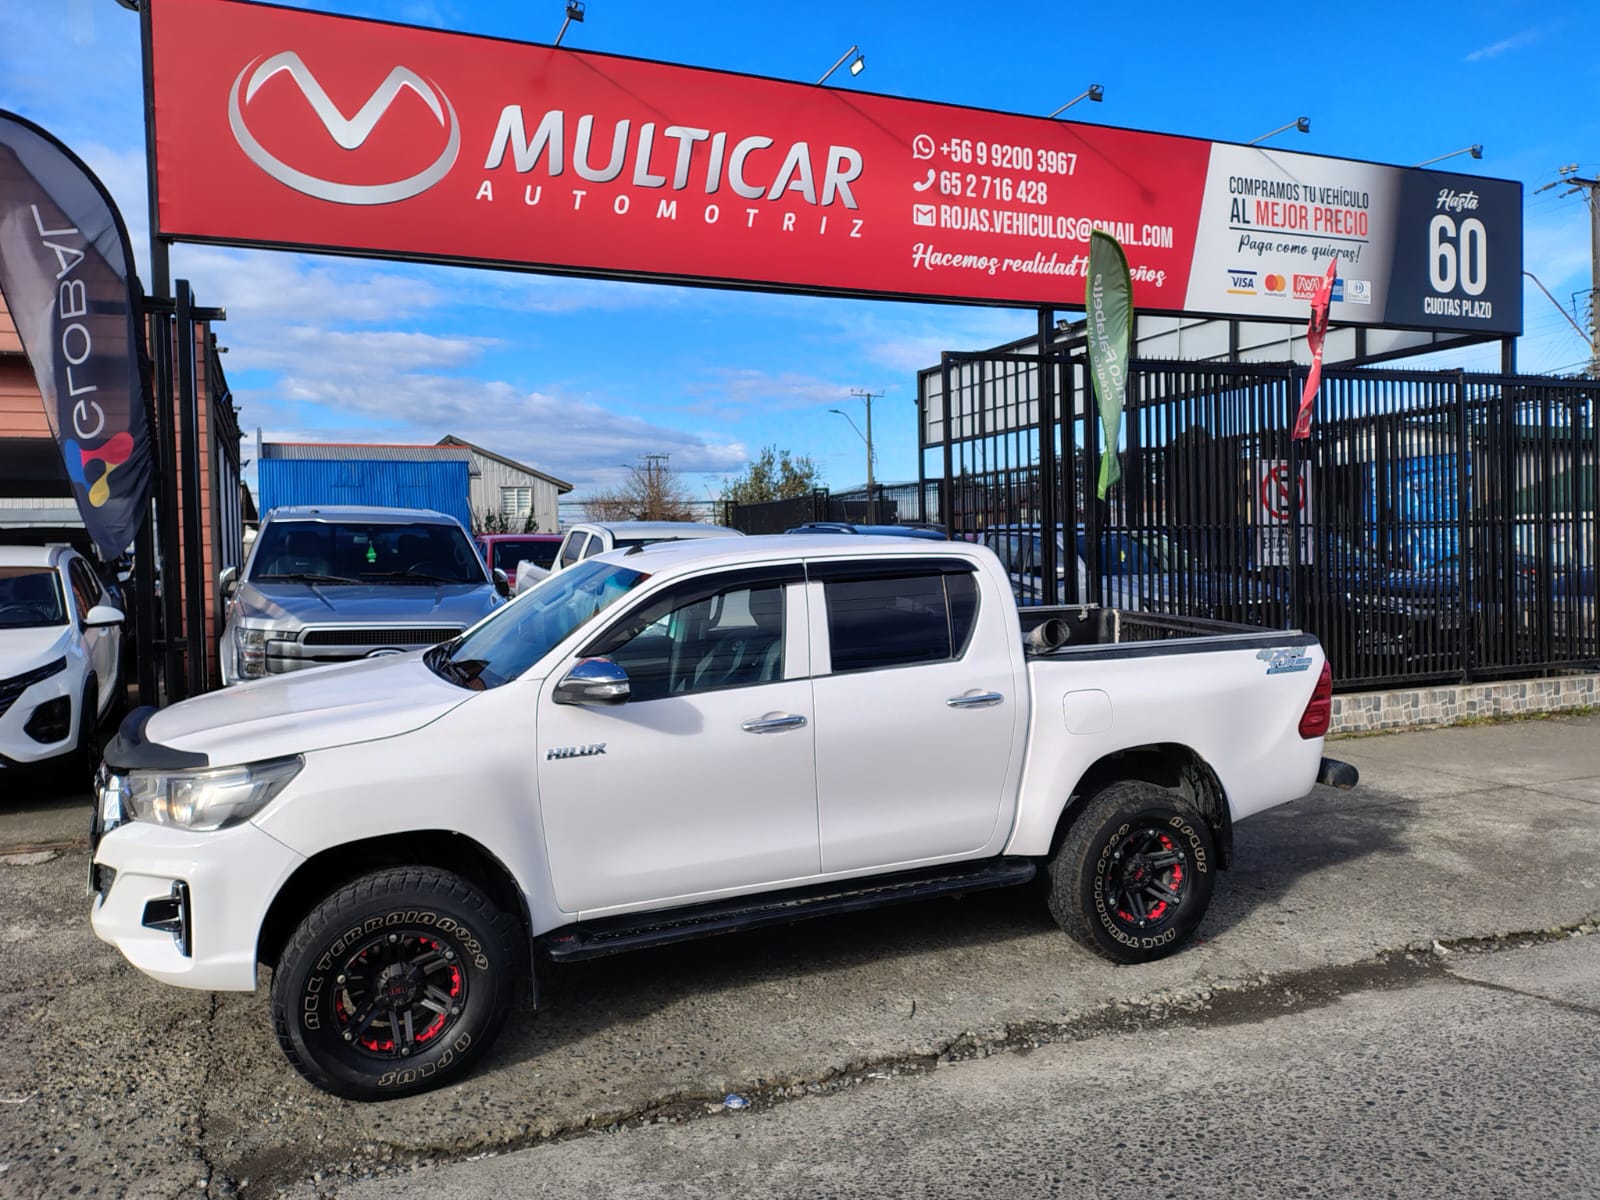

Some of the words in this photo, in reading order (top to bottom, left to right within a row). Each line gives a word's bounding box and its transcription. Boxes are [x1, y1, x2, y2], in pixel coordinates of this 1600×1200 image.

[484, 104, 864, 209] MULTICAR
[940, 138, 972, 163] +56
[976, 141, 987, 165] 9
[991, 144, 1033, 171] 9200
[1037, 149, 1077, 176] 3967
[940, 171, 961, 196] 65
[966, 174, 977, 198] 2
[981, 175, 1012, 201] 716
[1016, 180, 1047, 205] 428
[1229, 176, 1300, 201] COMPRAMOS
[1302, 185, 1316, 203] TU
[1319, 186, 1369, 209] VEHÍCULO
[1436, 188, 1480, 213] Hasta
[476, 181, 863, 238] AUTOMOTRIZ
[1230, 198, 1251, 224] AL
[1256, 200, 1308, 230] MEJOR
[1313, 207, 1368, 236] PRECIO
[912, 243, 1000, 275] Hacemos
[1002, 251, 1079, 276] realidad
[1129, 265, 1167, 287] eños
[1238, 234, 1273, 256] Paga
[1275, 243, 1309, 255] como
[1311, 245, 1361, 263] quieras!
[1429, 215, 1487, 296] 60
[1232, 277, 1254, 288] VISA
[1424, 296, 1460, 316] CUOTAS
[1462, 299, 1492, 319] PLAZO
[547, 743, 607, 760] HILUX
[1142, 928, 1176, 948] ALL
[304, 977, 324, 1030] ALL
